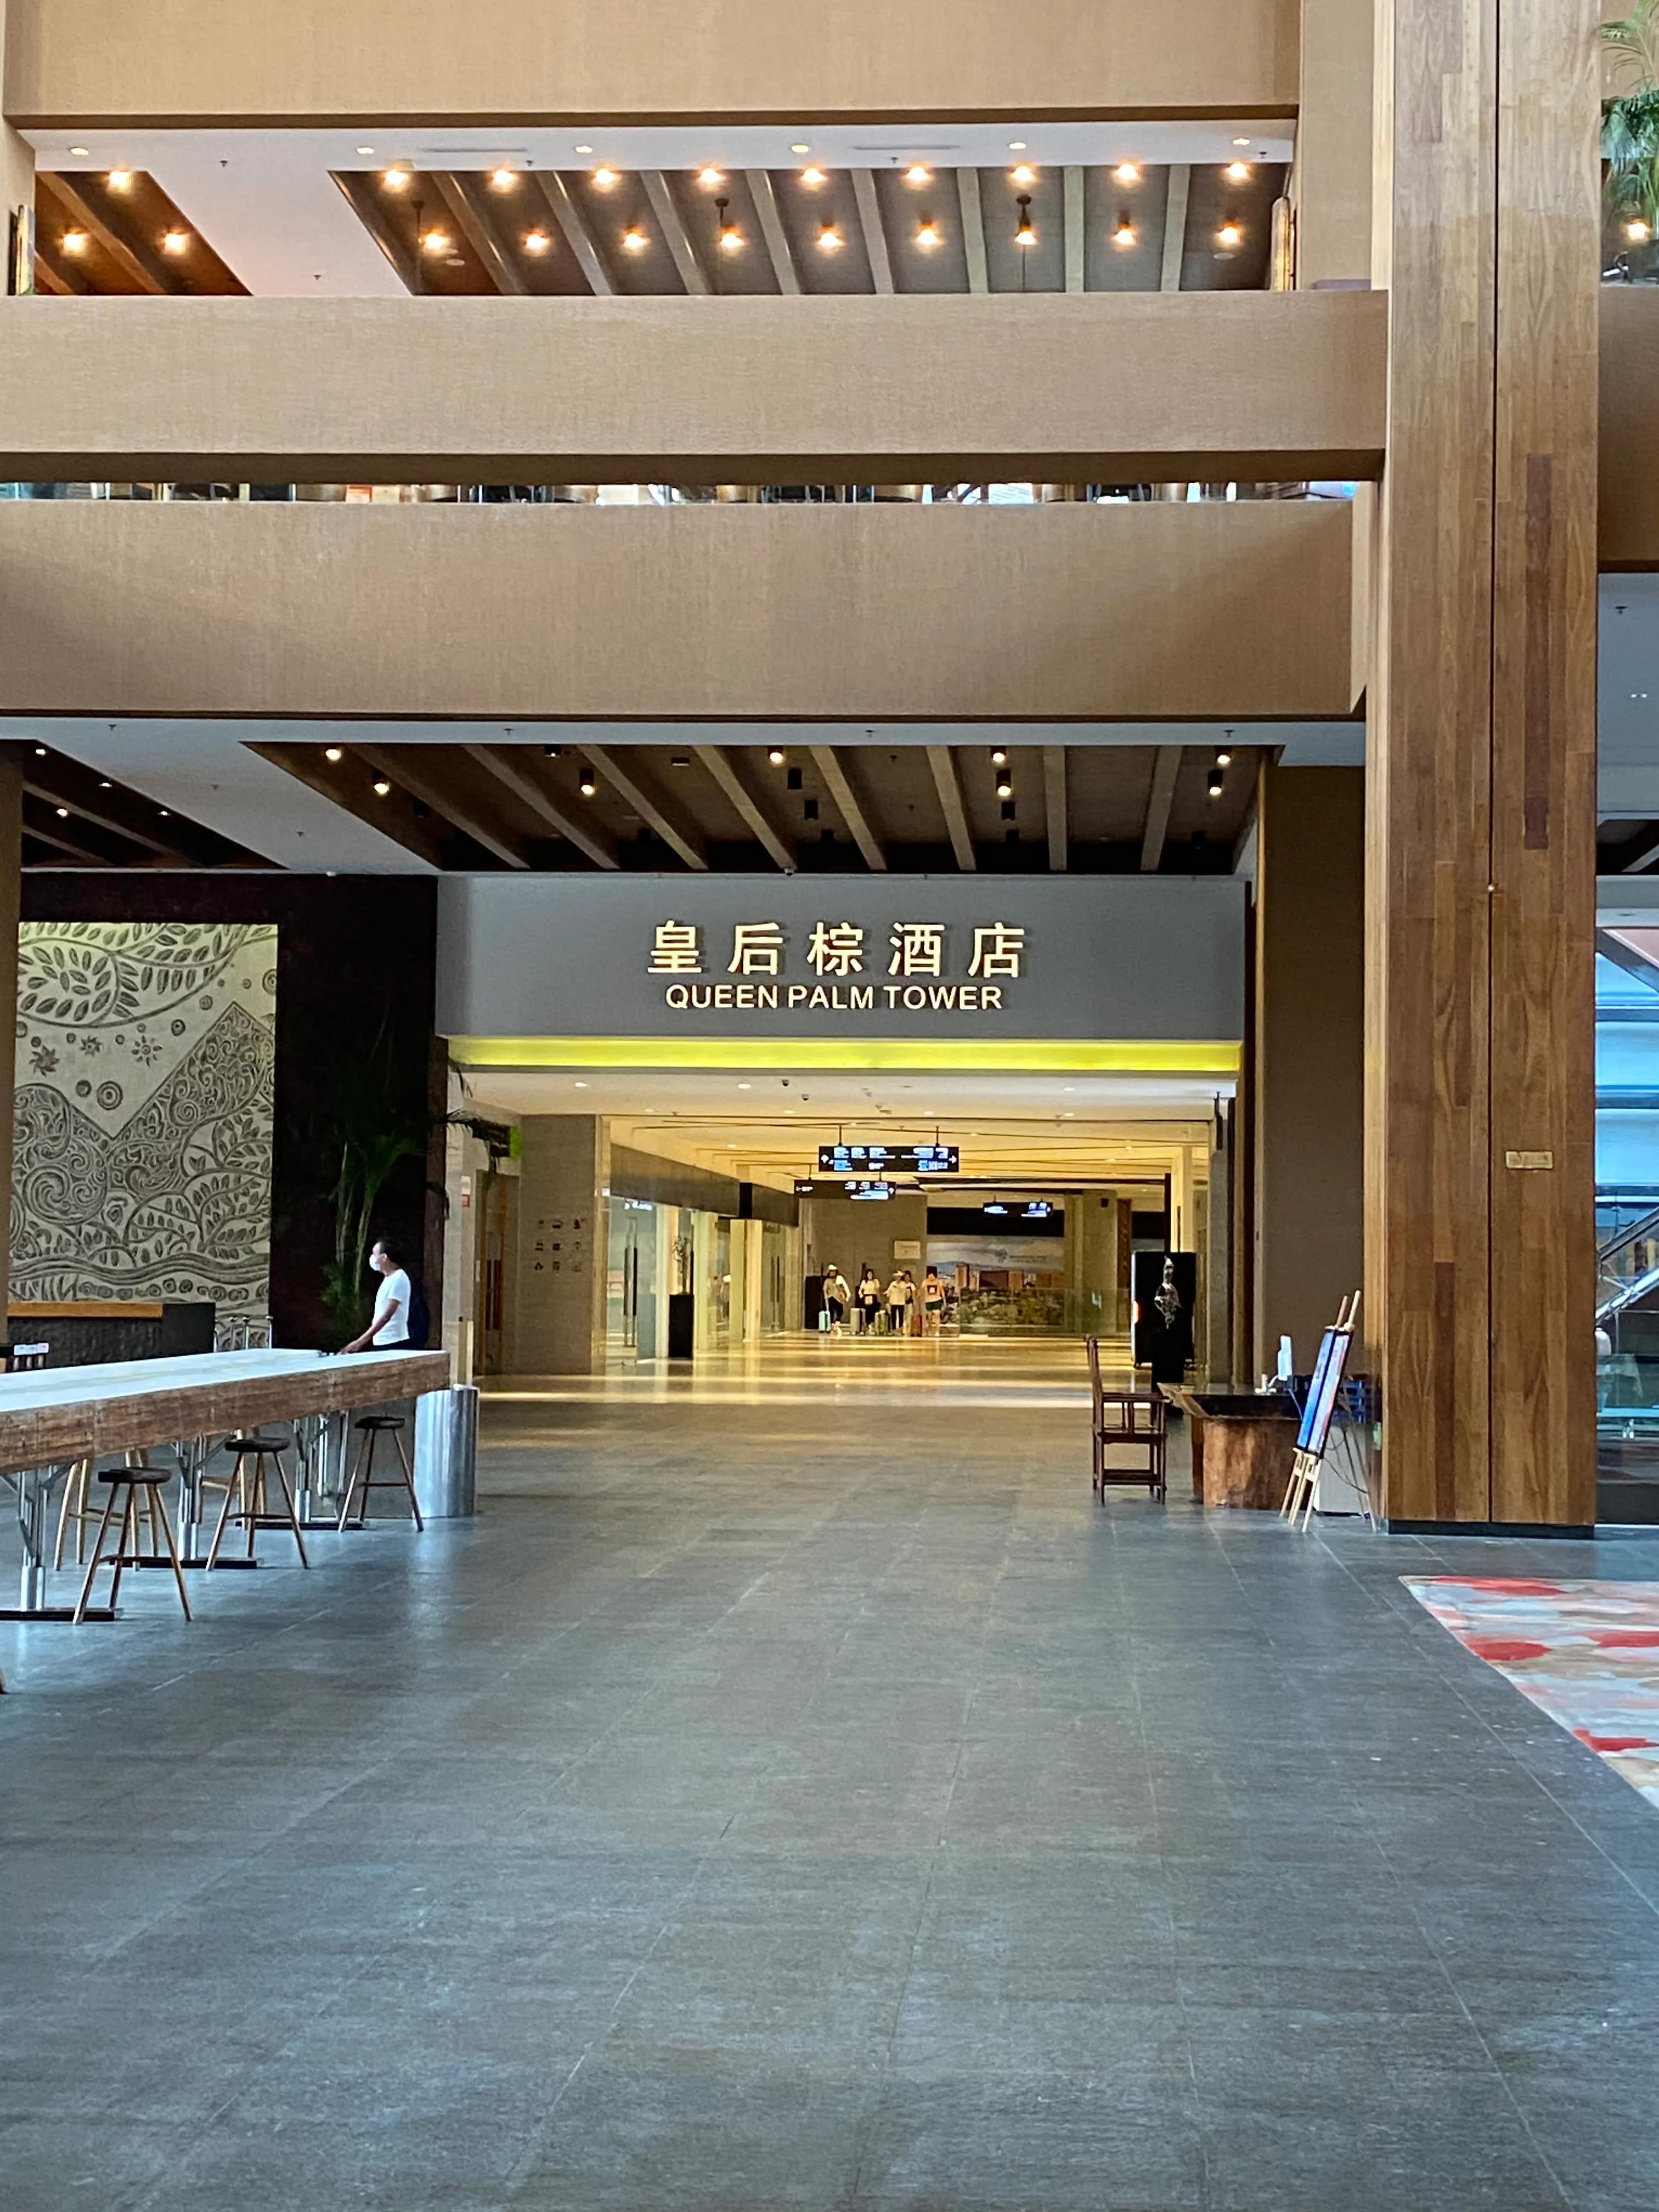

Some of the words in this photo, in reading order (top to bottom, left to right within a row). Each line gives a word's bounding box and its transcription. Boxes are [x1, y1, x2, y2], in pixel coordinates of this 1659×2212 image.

[647, 920, 1025, 978] 皇后棕酒店
[665, 984, 777, 1009] QUEEN
[787, 984, 874, 1010] PALM
[883, 985, 1003, 1011] TOWER
